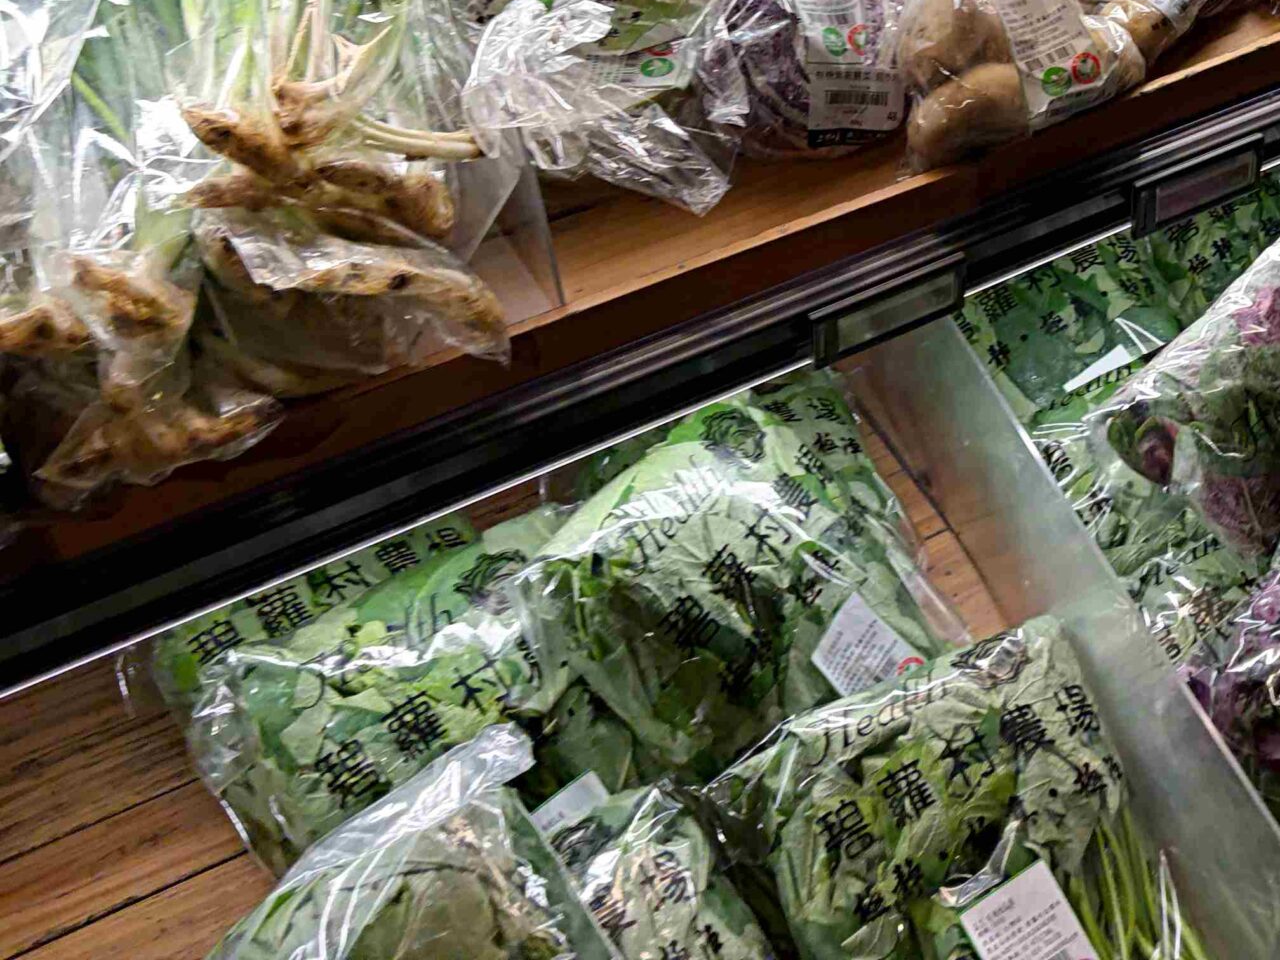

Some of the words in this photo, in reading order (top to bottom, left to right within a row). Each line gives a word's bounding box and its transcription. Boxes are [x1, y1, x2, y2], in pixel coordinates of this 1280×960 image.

[816, 684, 1102, 859] 碧蘿村農場
